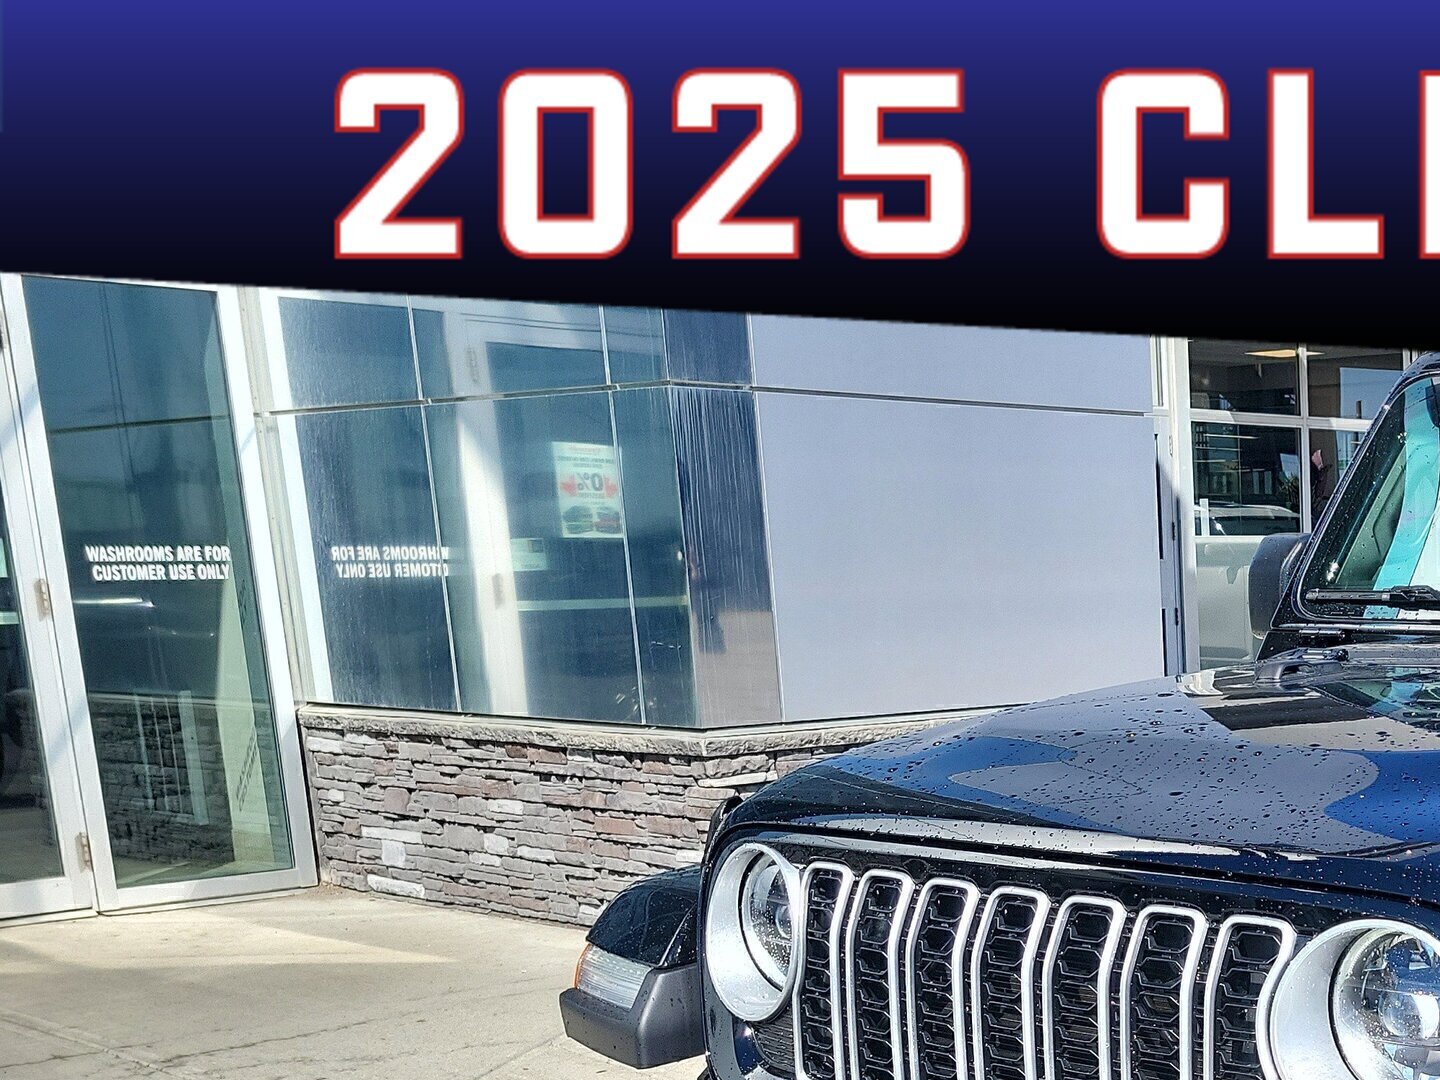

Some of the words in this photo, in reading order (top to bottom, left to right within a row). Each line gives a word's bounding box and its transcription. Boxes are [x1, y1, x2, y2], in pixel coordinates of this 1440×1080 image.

[85, 545, 174, 562] WASHROOMS
[176, 545, 202, 562] ARE
[204, 545, 232, 562] FOR
[92, 564, 167, 581] CUSTOMER
[168, 564, 196, 580] USE
[197, 563, 230, 580] ONLY
